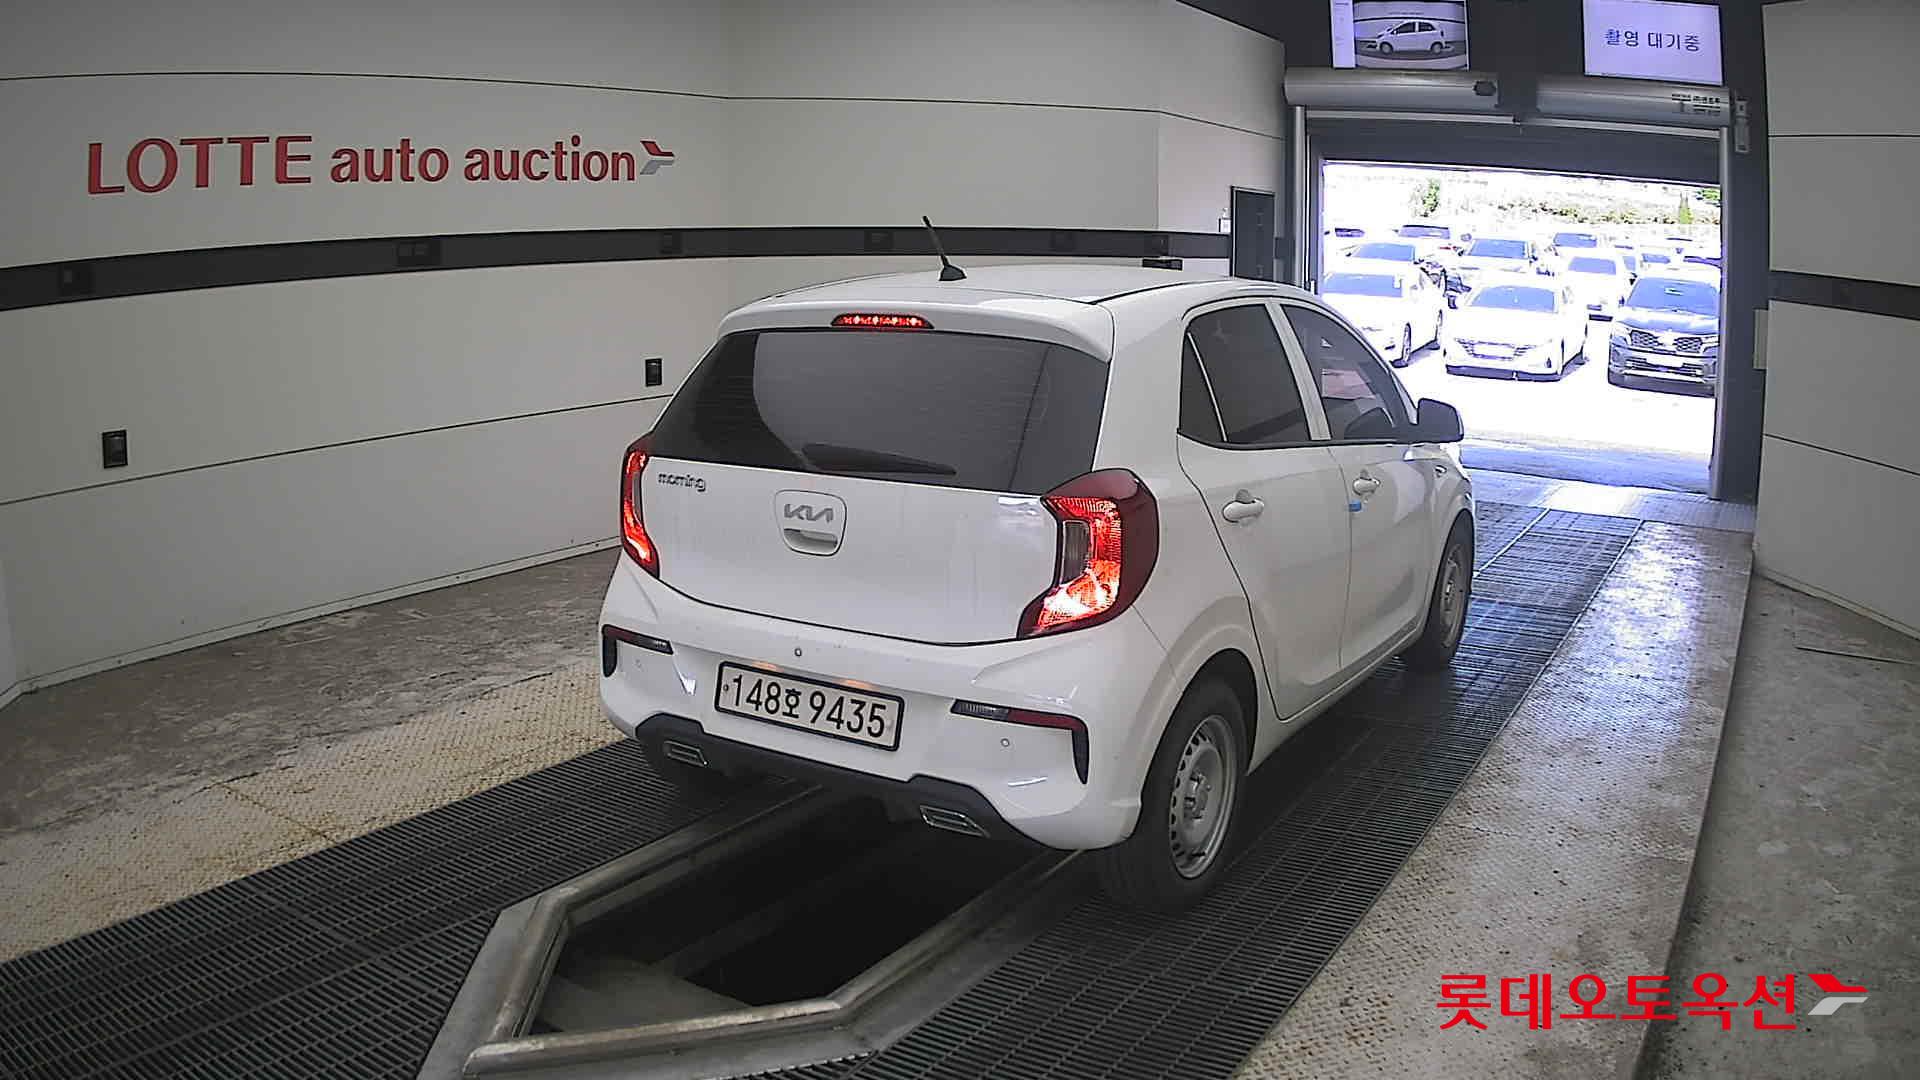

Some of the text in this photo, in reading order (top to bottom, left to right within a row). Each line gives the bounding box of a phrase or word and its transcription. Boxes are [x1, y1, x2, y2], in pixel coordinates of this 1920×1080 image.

[1604, 28, 1701, 52] 촬영 대기중
[87, 134, 636, 195] LOTTE auto auction
[658, 472, 706, 492] morning
[732, 674, 887, 738] 148호 9435
